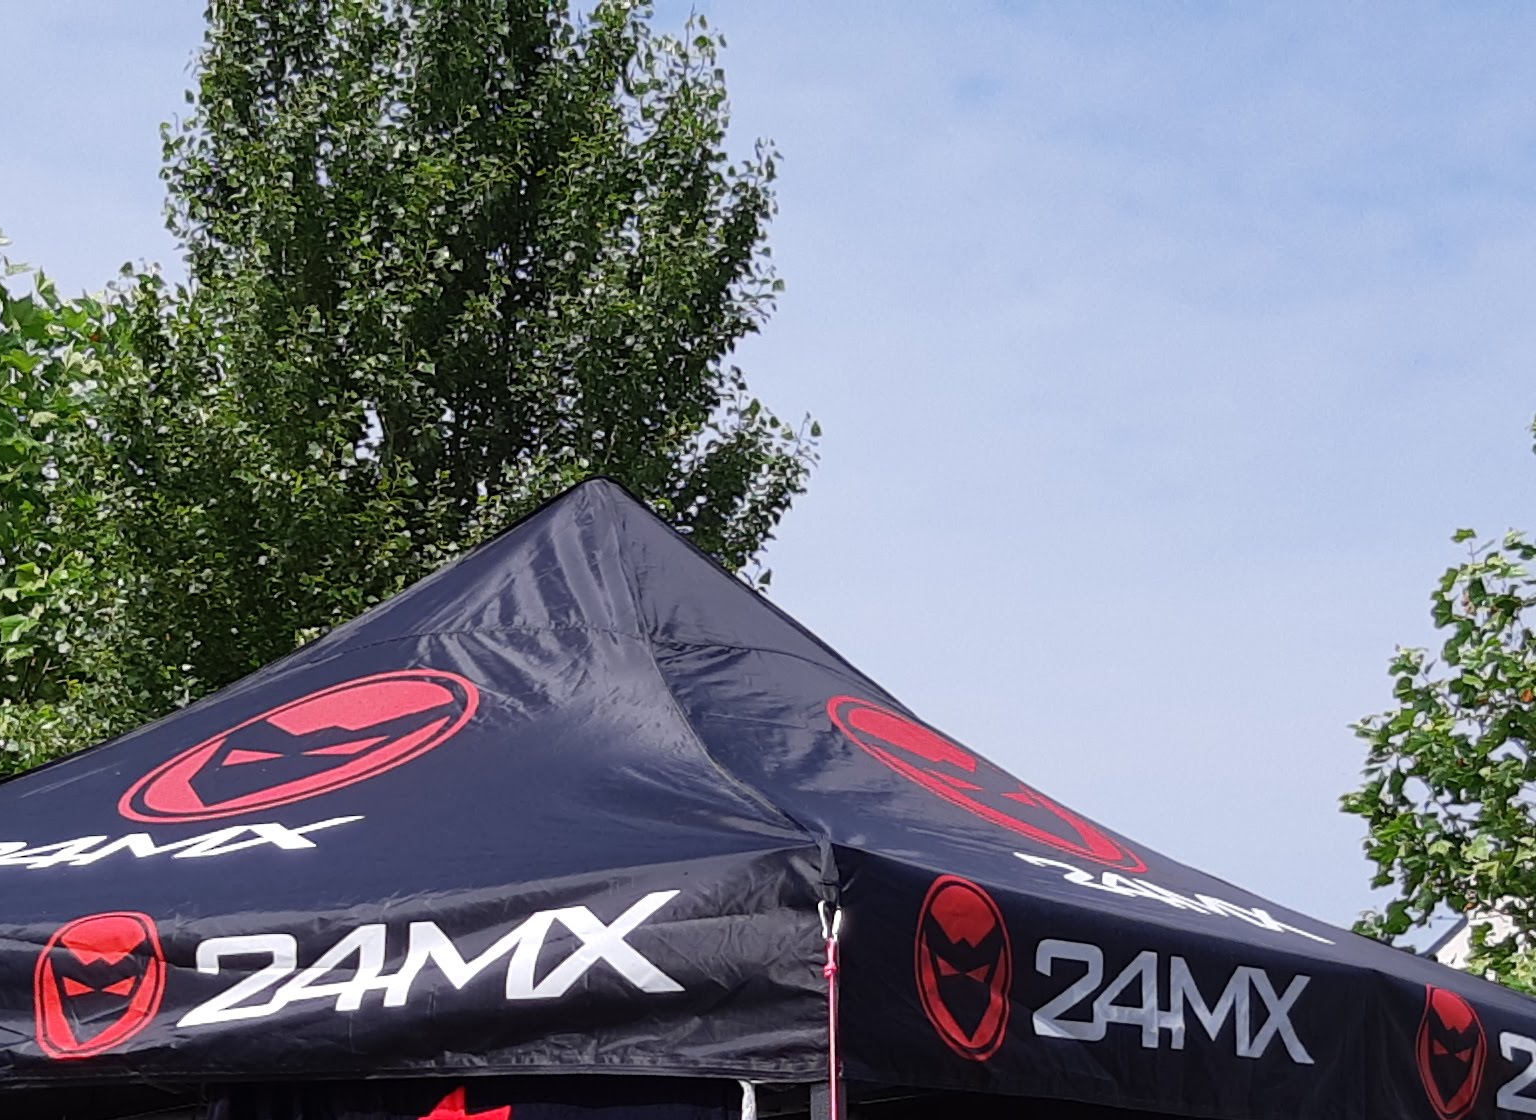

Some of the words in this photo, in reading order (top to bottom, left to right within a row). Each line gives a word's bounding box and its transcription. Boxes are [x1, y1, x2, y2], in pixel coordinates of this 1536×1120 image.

[175, 888, 686, 1028] 24MX
[1013, 850, 1337, 946] 24MX
[1031, 938, 1316, 1065] 24MX
